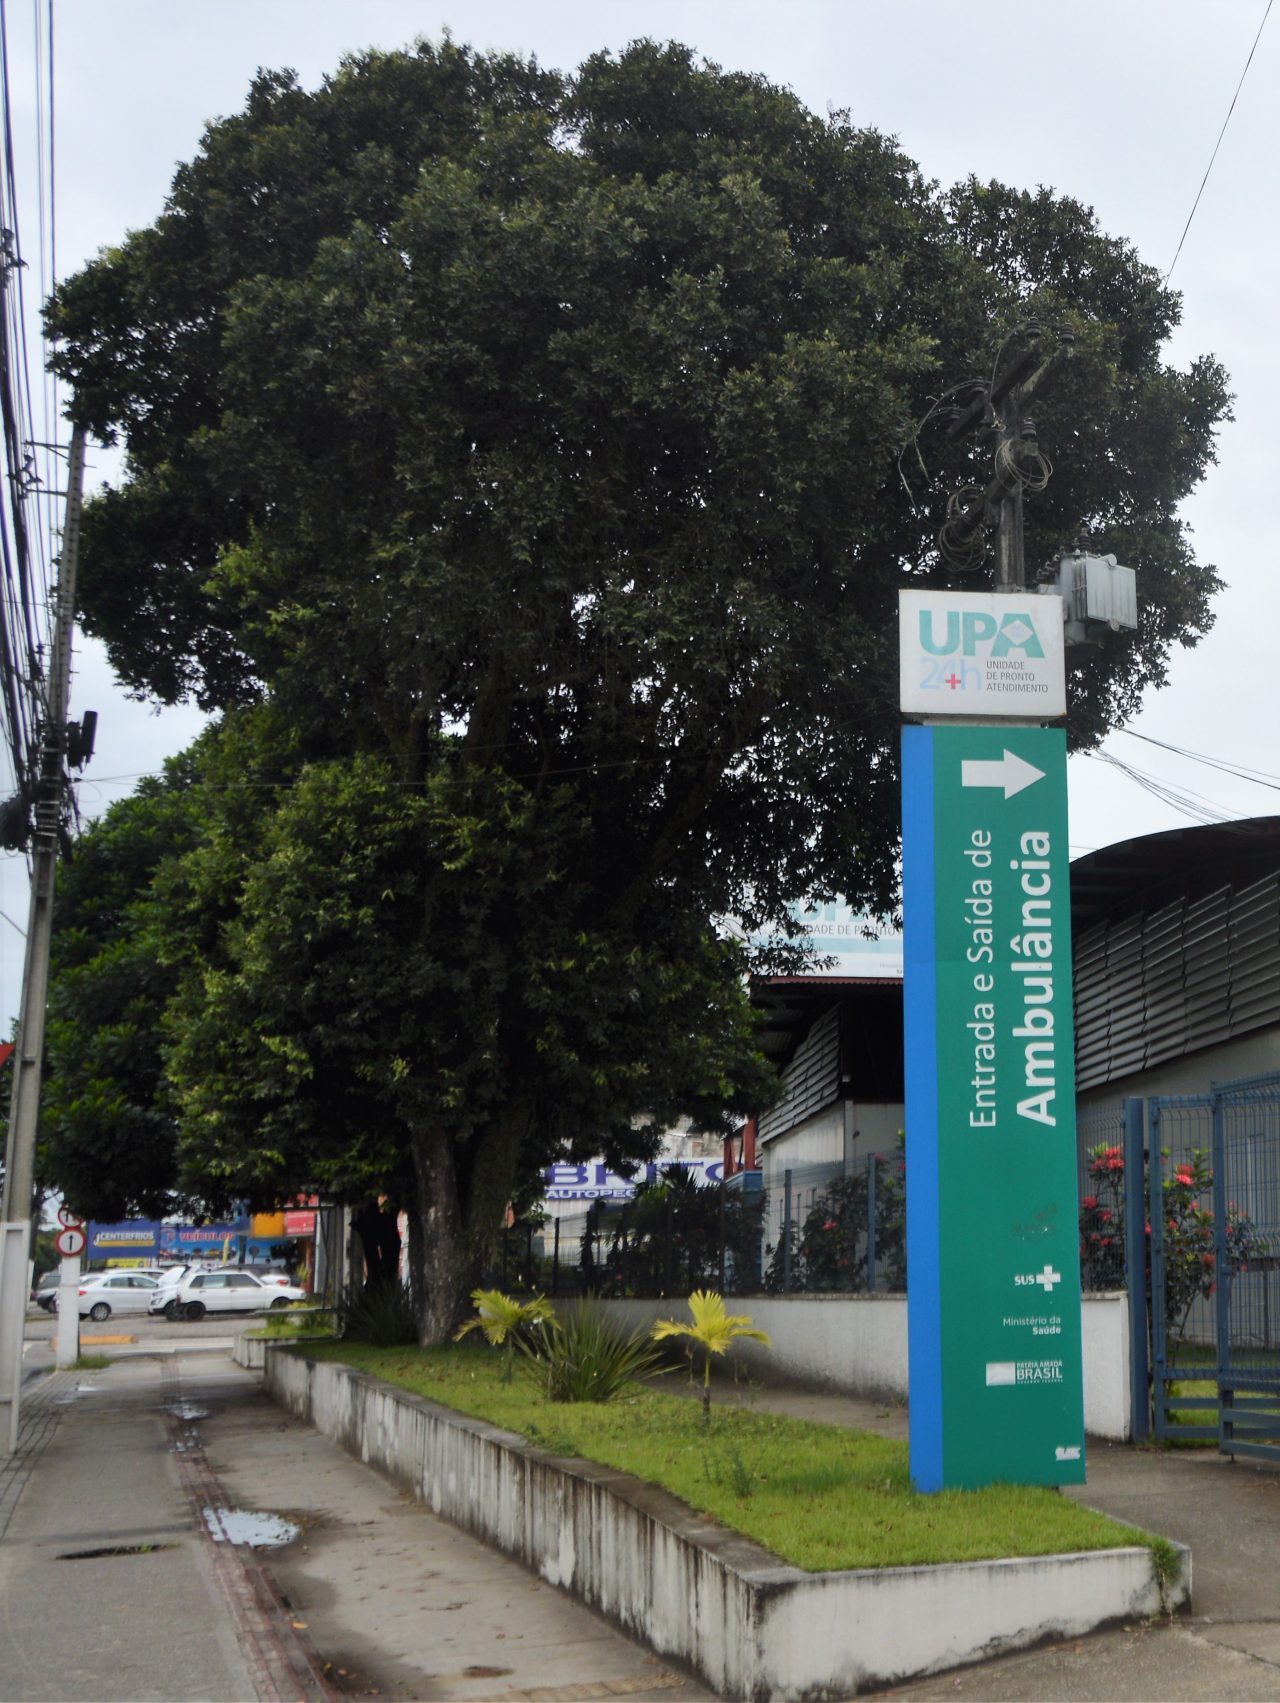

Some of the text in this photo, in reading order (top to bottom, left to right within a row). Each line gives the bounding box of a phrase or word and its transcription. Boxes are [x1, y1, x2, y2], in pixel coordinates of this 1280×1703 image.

[919, 610, 1045, 658] UPA
[986, 661, 1025, 671] UNIDADE
[986, 672, 1035, 682] DE PRONTO
[986, 683, 1049, 693] ATENDIMENTO
[963, 830, 996, 1128] Entrada e Saída de
[1009, 831, 1057, 1127] Ambulância
[1014, 1274, 1035, 1286] SUS
[1003, 1315, 1061, 1327] Ministério da
[1033, 1326, 1061, 1336] Saúde
[1016, 1367, 1063, 1381] BRASIL
